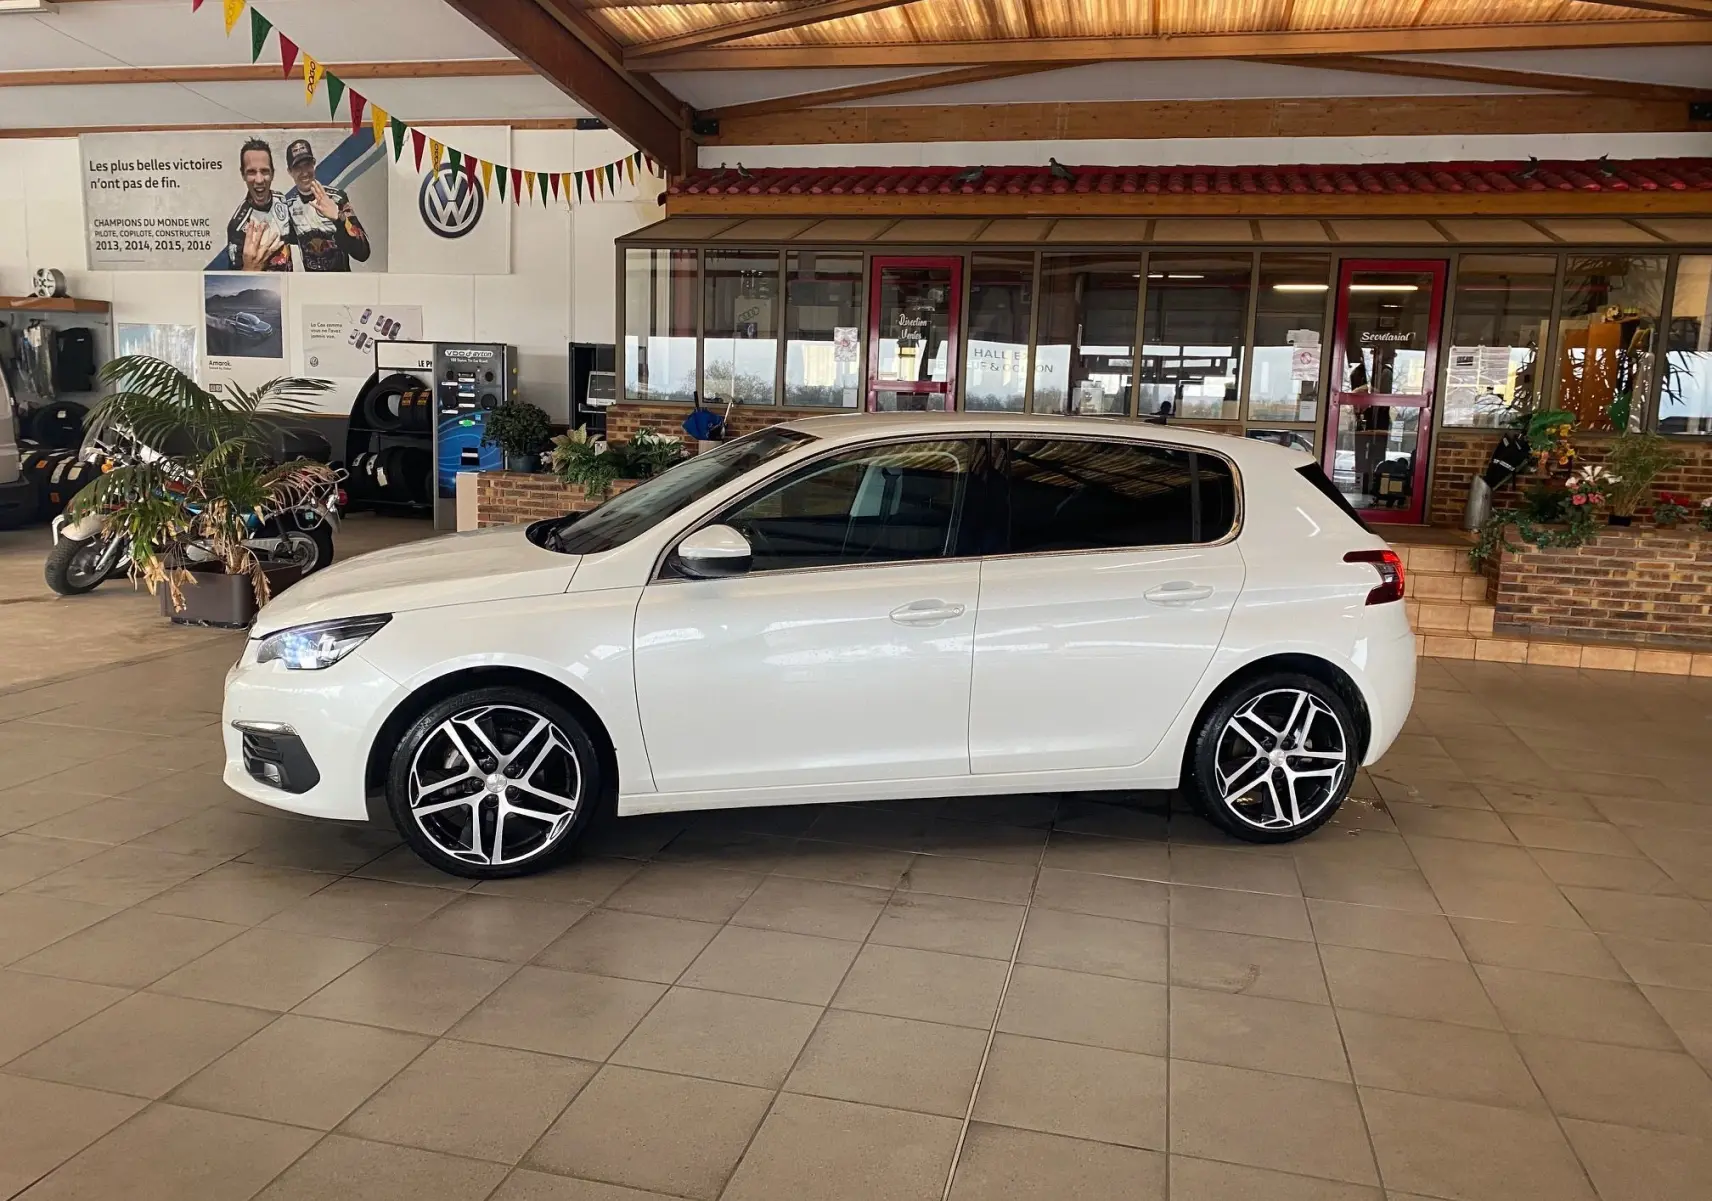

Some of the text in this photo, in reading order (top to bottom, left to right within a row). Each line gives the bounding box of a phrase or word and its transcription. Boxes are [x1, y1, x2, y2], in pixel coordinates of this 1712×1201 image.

[89, 158, 223, 174] Les plus belles victoires
[122, 180, 142, 191] pas
[145, 177, 159, 189] de
[161, 176, 180, 189] fin.
[93, 218, 210, 227] CHAMPIONS DU MONDE WRC
[94, 229, 211, 238] PILOTE, COPILOTE, CONSTRUCTEUR
[95, 240, 122, 252] 2013,
[124, 240, 153, 252] 2014,
[155, 240, 184, 252] 2015,
[974, 348, 1009, 359] HALL
